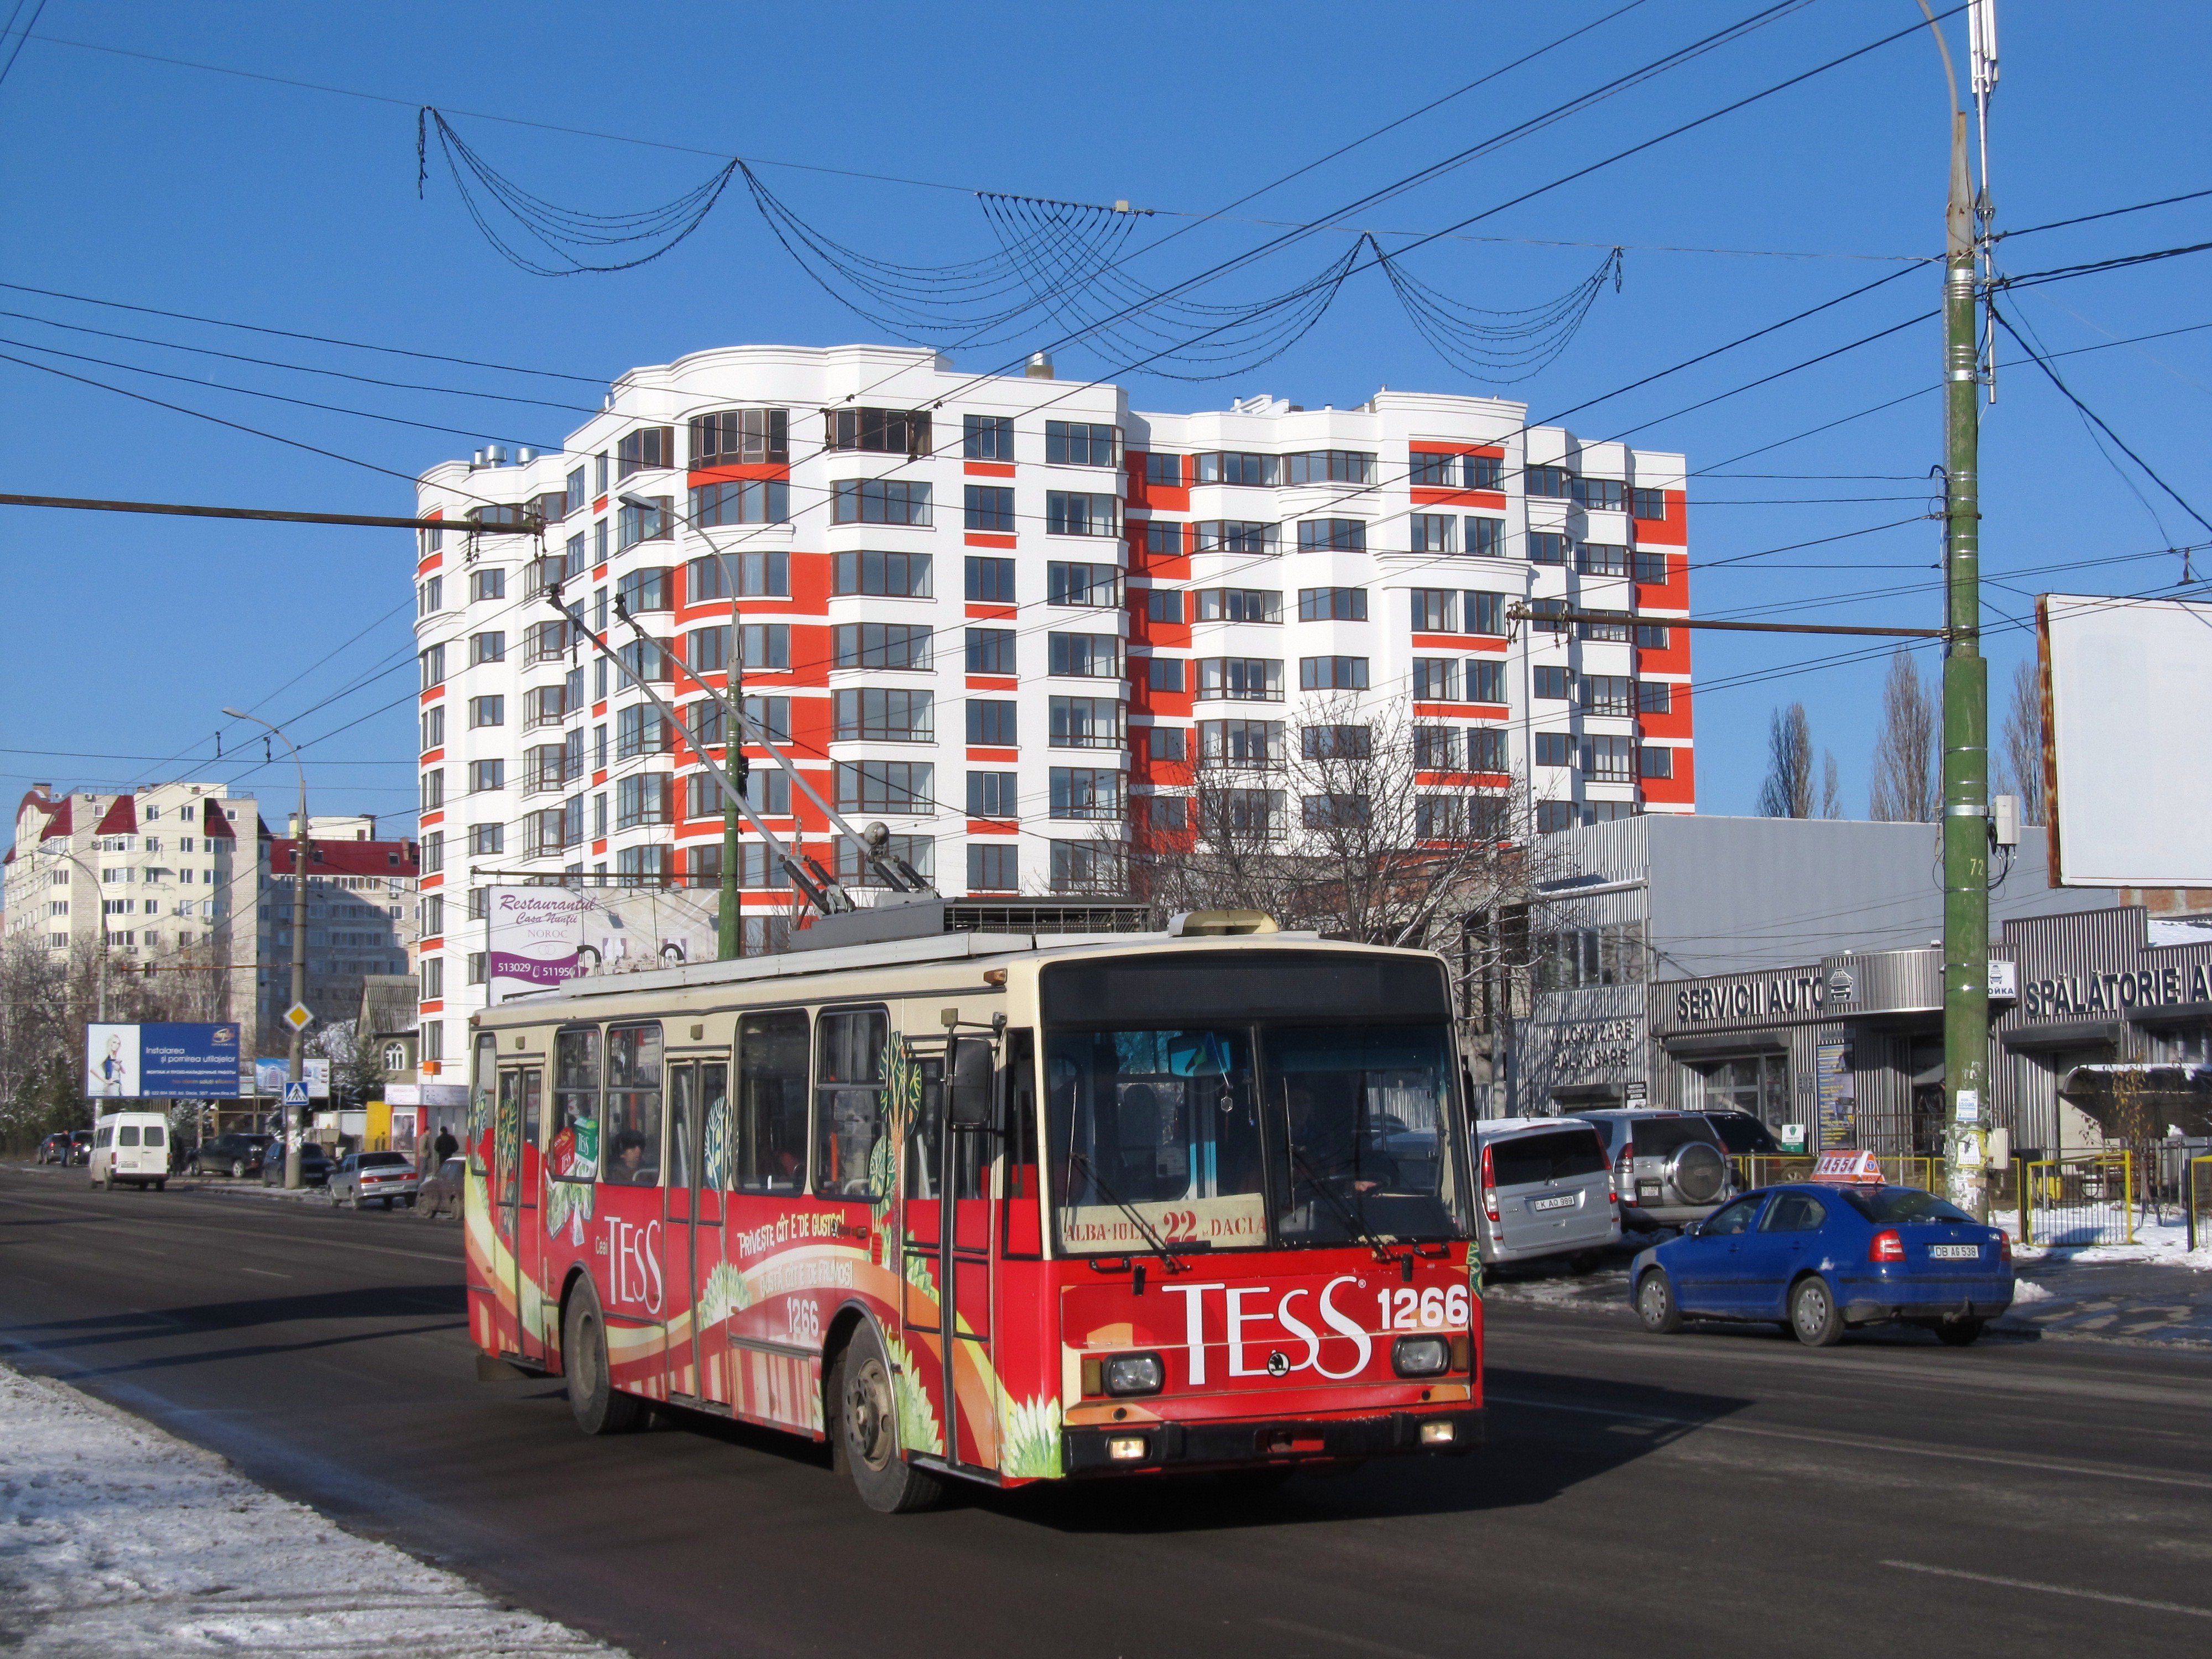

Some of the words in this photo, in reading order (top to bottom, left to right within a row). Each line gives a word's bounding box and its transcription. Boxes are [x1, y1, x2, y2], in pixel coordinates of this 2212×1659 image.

[1970, 858, 1983, 875] 72
[499, 894, 596, 911] Restaurantul
[516, 912, 542, 925] Casa
[528, 930, 568, 938] NOROC
[498, 963, 531, 972] 513029
[1678, 980, 1765, 1022] SERVICII
[1769, 976, 1823, 1014] AUTO
[2025, 968, 2180, 1017] SPĂLĂTORIE
[1549, 1022, 1632, 1046] VULCANIZARE
[203, 1055, 236, 1063] utilajelor
[1554, 1048, 1628, 1070] BALANSARE
[1817, 1158, 1858, 1172] 14554
[791, 1214, 797, 1239] E
[797, 1213, 809, 1237] DE
[1164, 1211, 1198, 1244] 22
[1211, 1217, 1266, 1237] DACIA
[596, 1236, 608, 1255] Ceai
[1951, 1247, 1960, 1256] AG
[1961, 1247, 1976, 1256] 538
[604, 1216, 661, 1314] TESS
[787, 1297, 818, 1337] 1266
[1378, 1285, 1468, 1329] 1266
